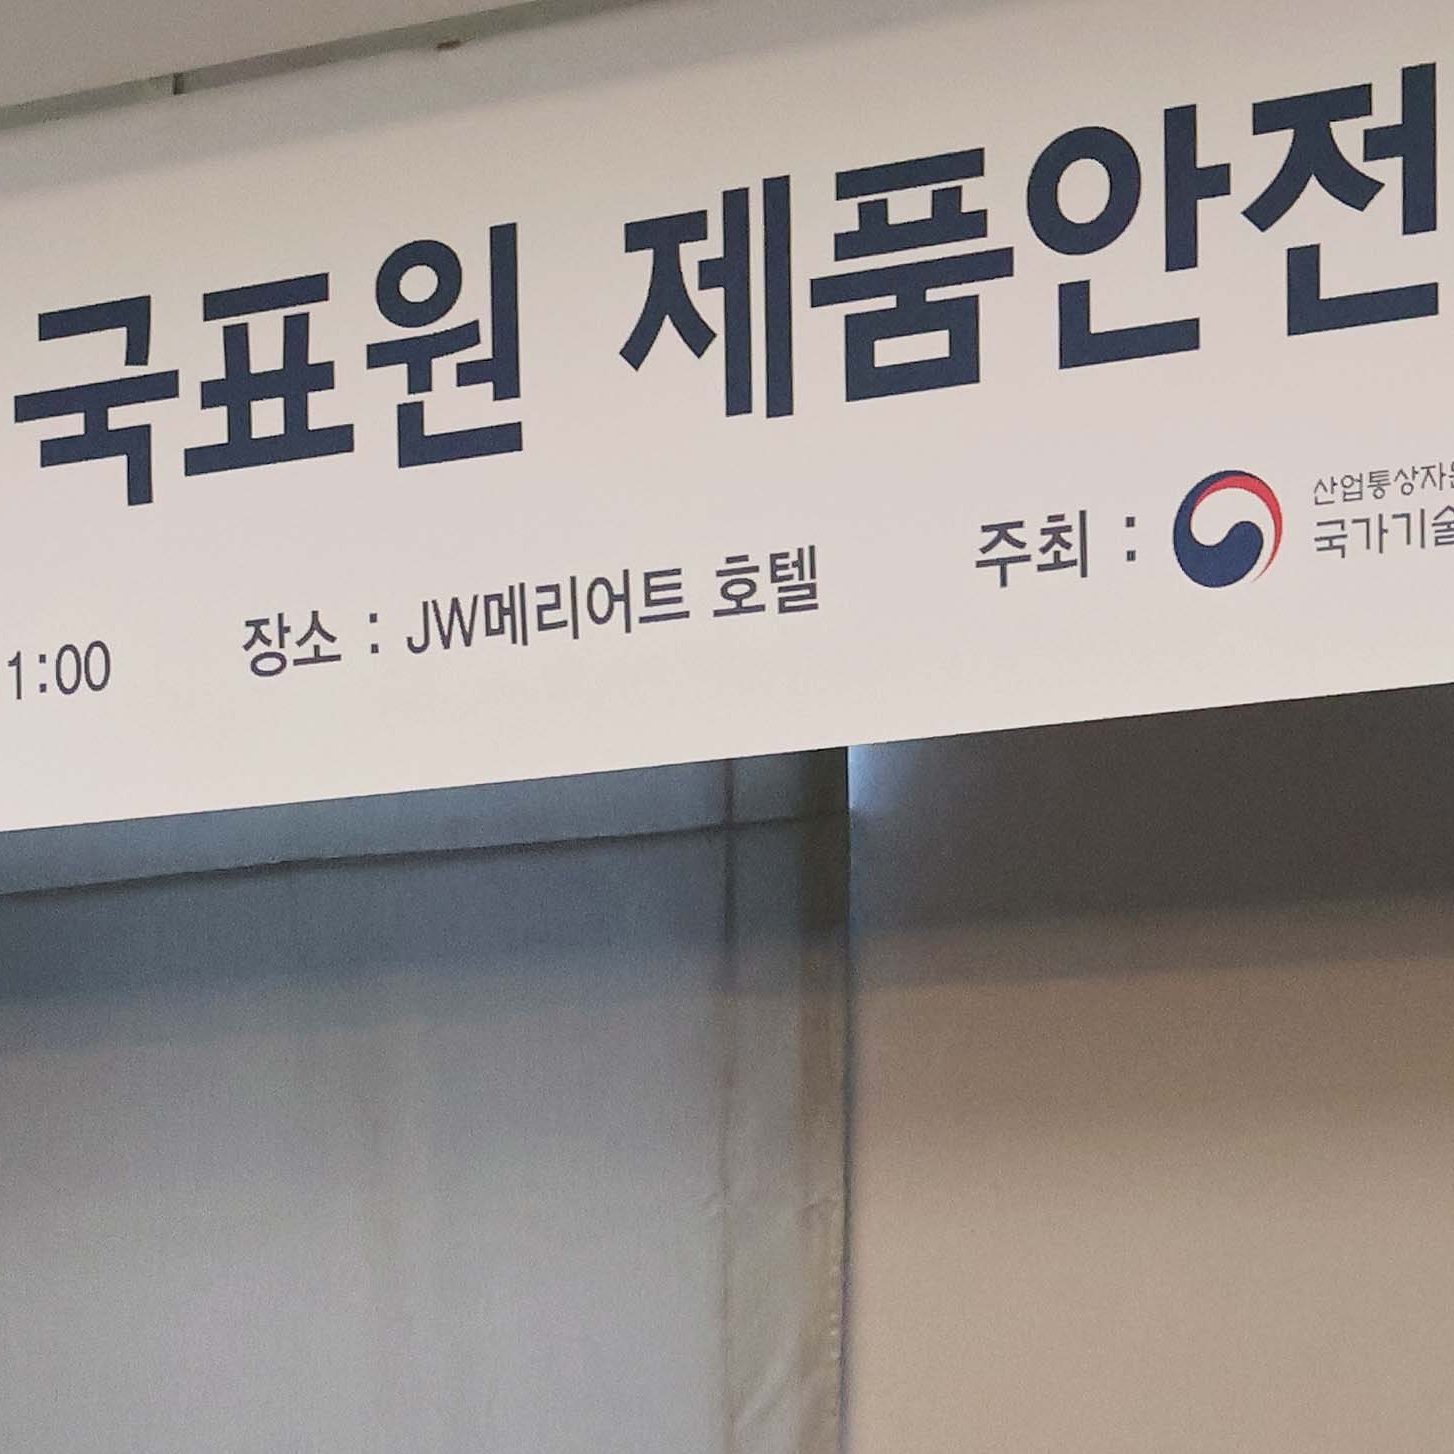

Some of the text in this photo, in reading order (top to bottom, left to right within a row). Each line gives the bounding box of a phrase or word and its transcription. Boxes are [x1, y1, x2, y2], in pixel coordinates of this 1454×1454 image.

[13, 222, 524, 507] 국표원
[618, 61, 1439, 419] 제품안전
[1313, 460, 1454, 507] 산업통상자
[975, 509, 1089, 588] 주최
[242, 610, 342, 677] 장소
[406, 567, 690, 654] JW메리어트
[713, 544, 819, 618] 호텔
